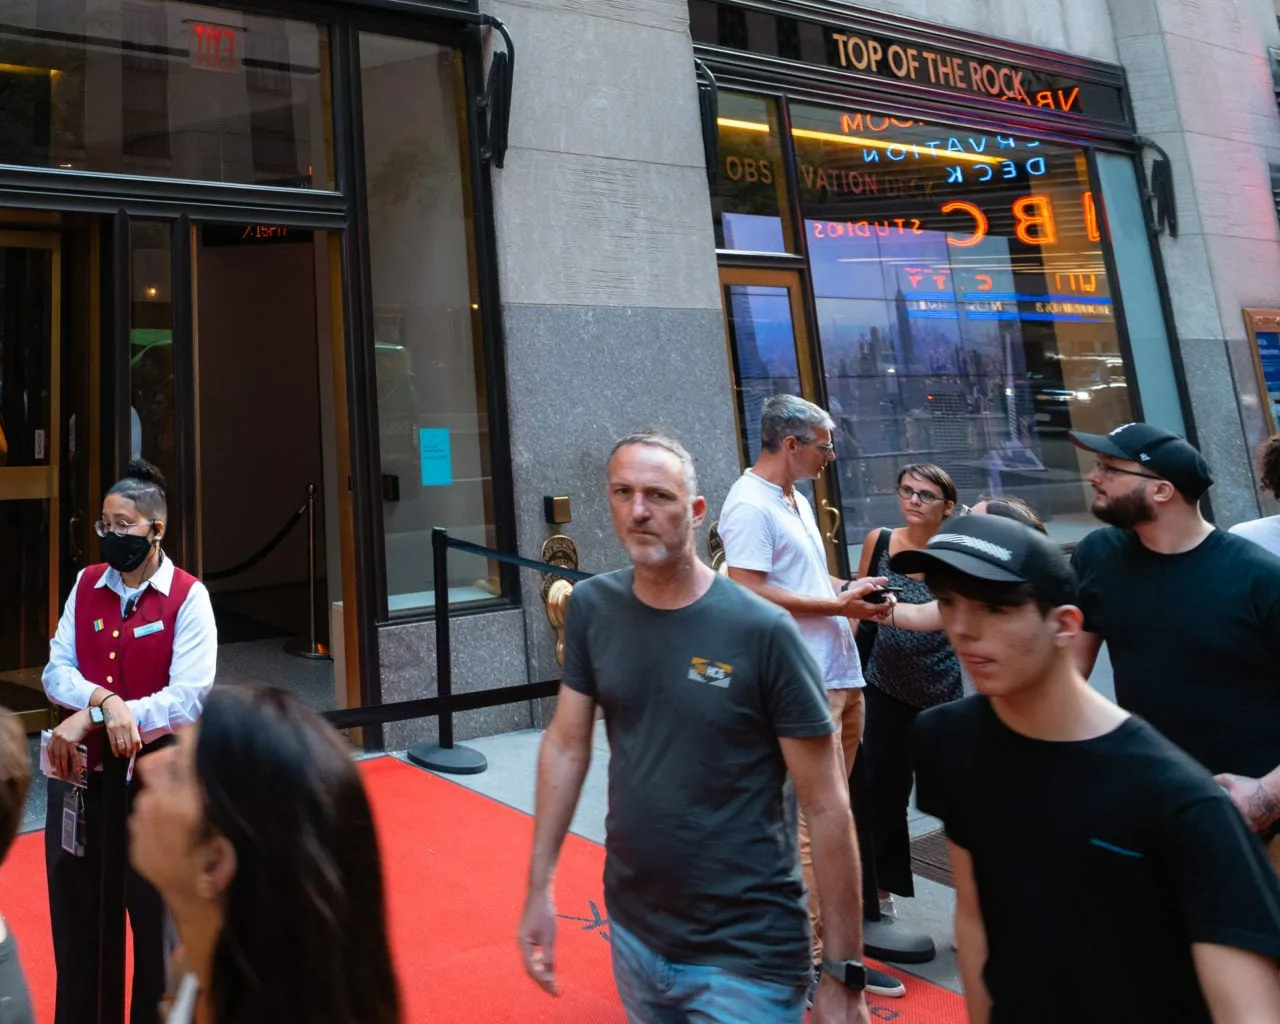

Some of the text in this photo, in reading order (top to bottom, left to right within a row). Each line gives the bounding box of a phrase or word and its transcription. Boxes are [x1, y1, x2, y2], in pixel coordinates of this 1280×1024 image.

[832, 33, 1032, 106] TOP OF THE ROCK
